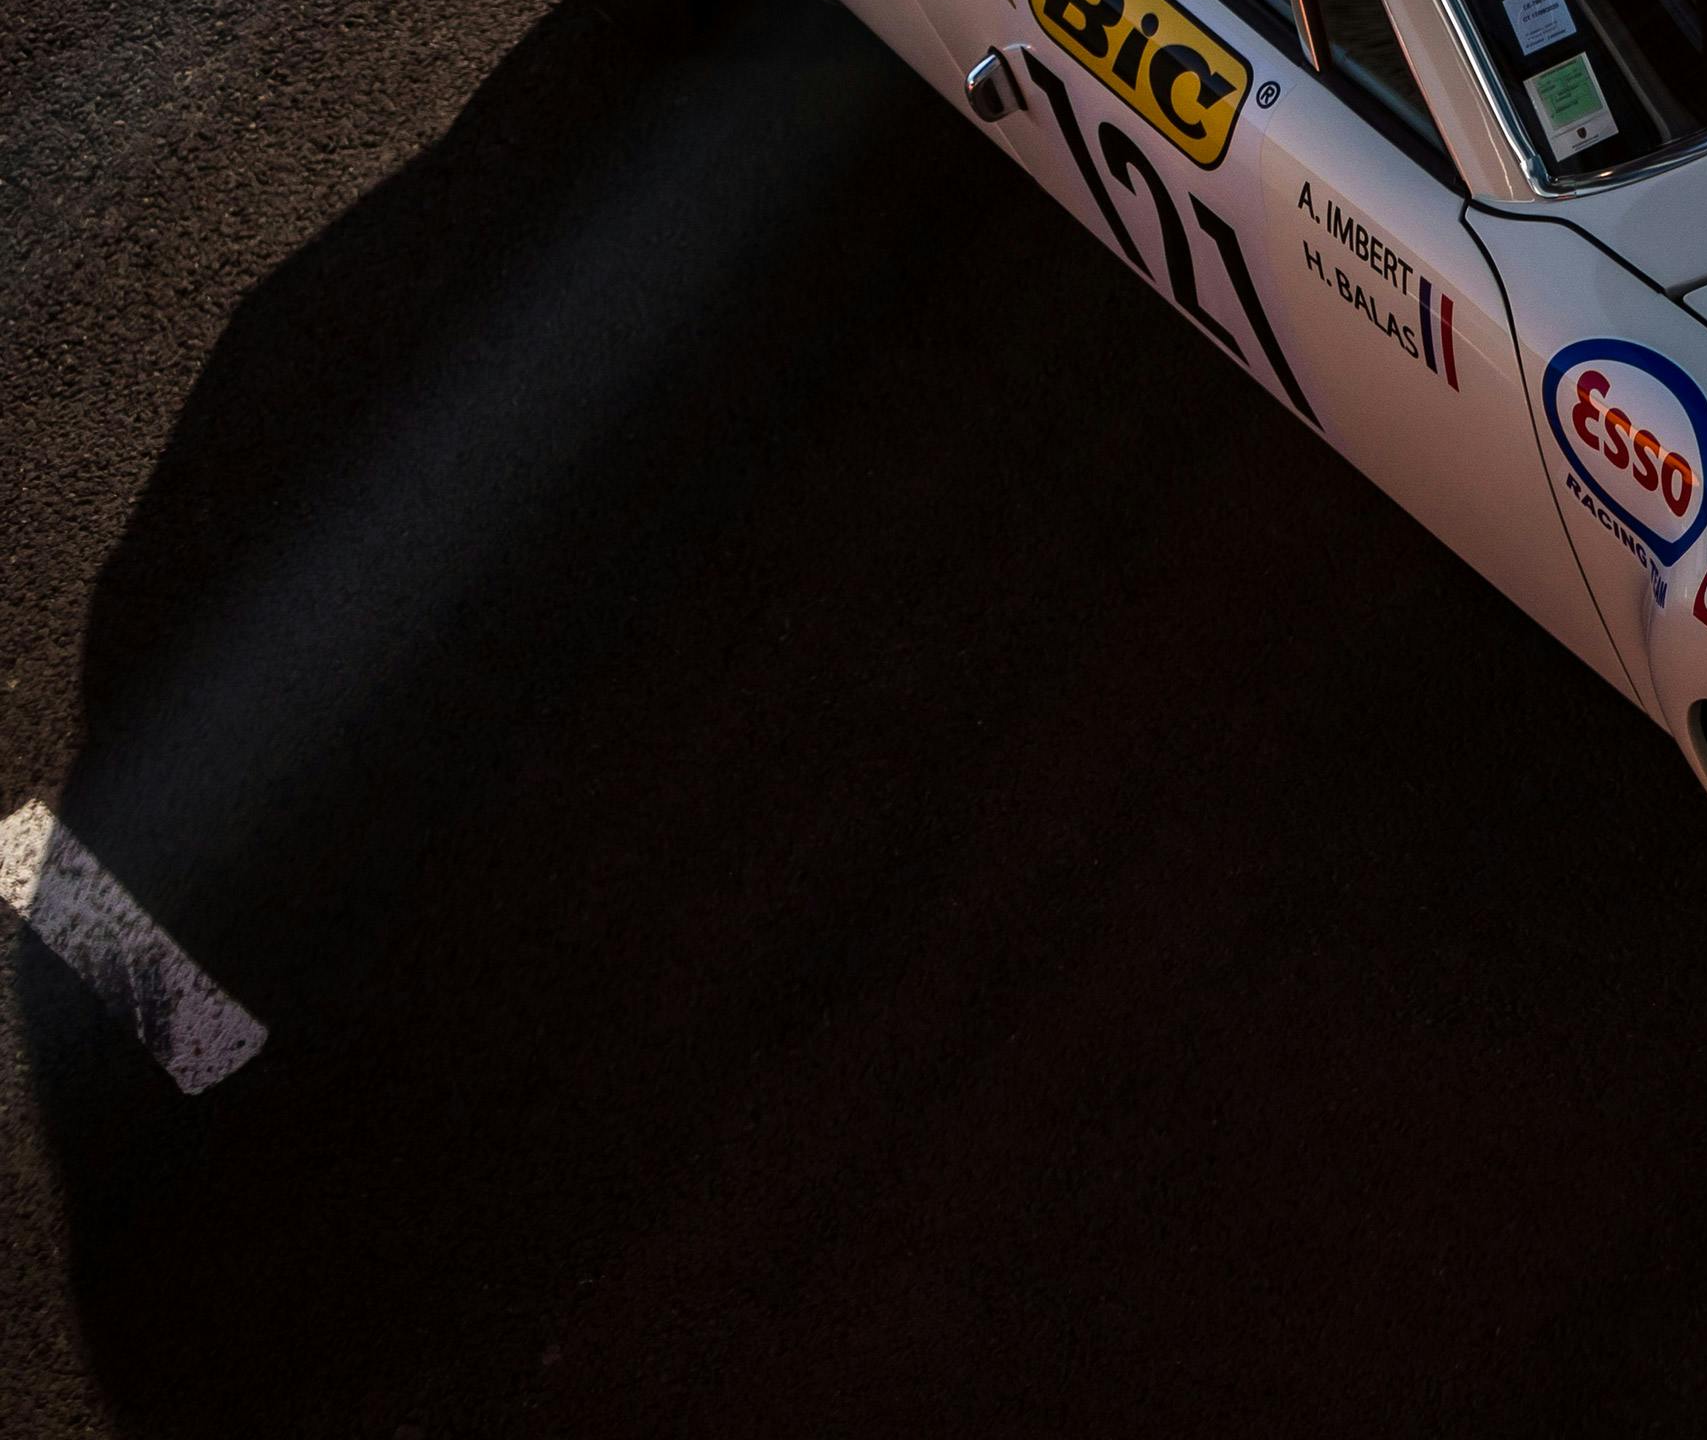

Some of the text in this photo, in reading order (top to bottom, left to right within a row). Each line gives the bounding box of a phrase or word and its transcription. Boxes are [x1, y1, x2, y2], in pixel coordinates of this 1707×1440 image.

[1021, 46, 1326, 432] 121
[1298, 182, 1414, 296] A. IMBERT
[1304, 241, 1419, 360] H. BALAS
[1566, 473, 1647, 568] RACING
